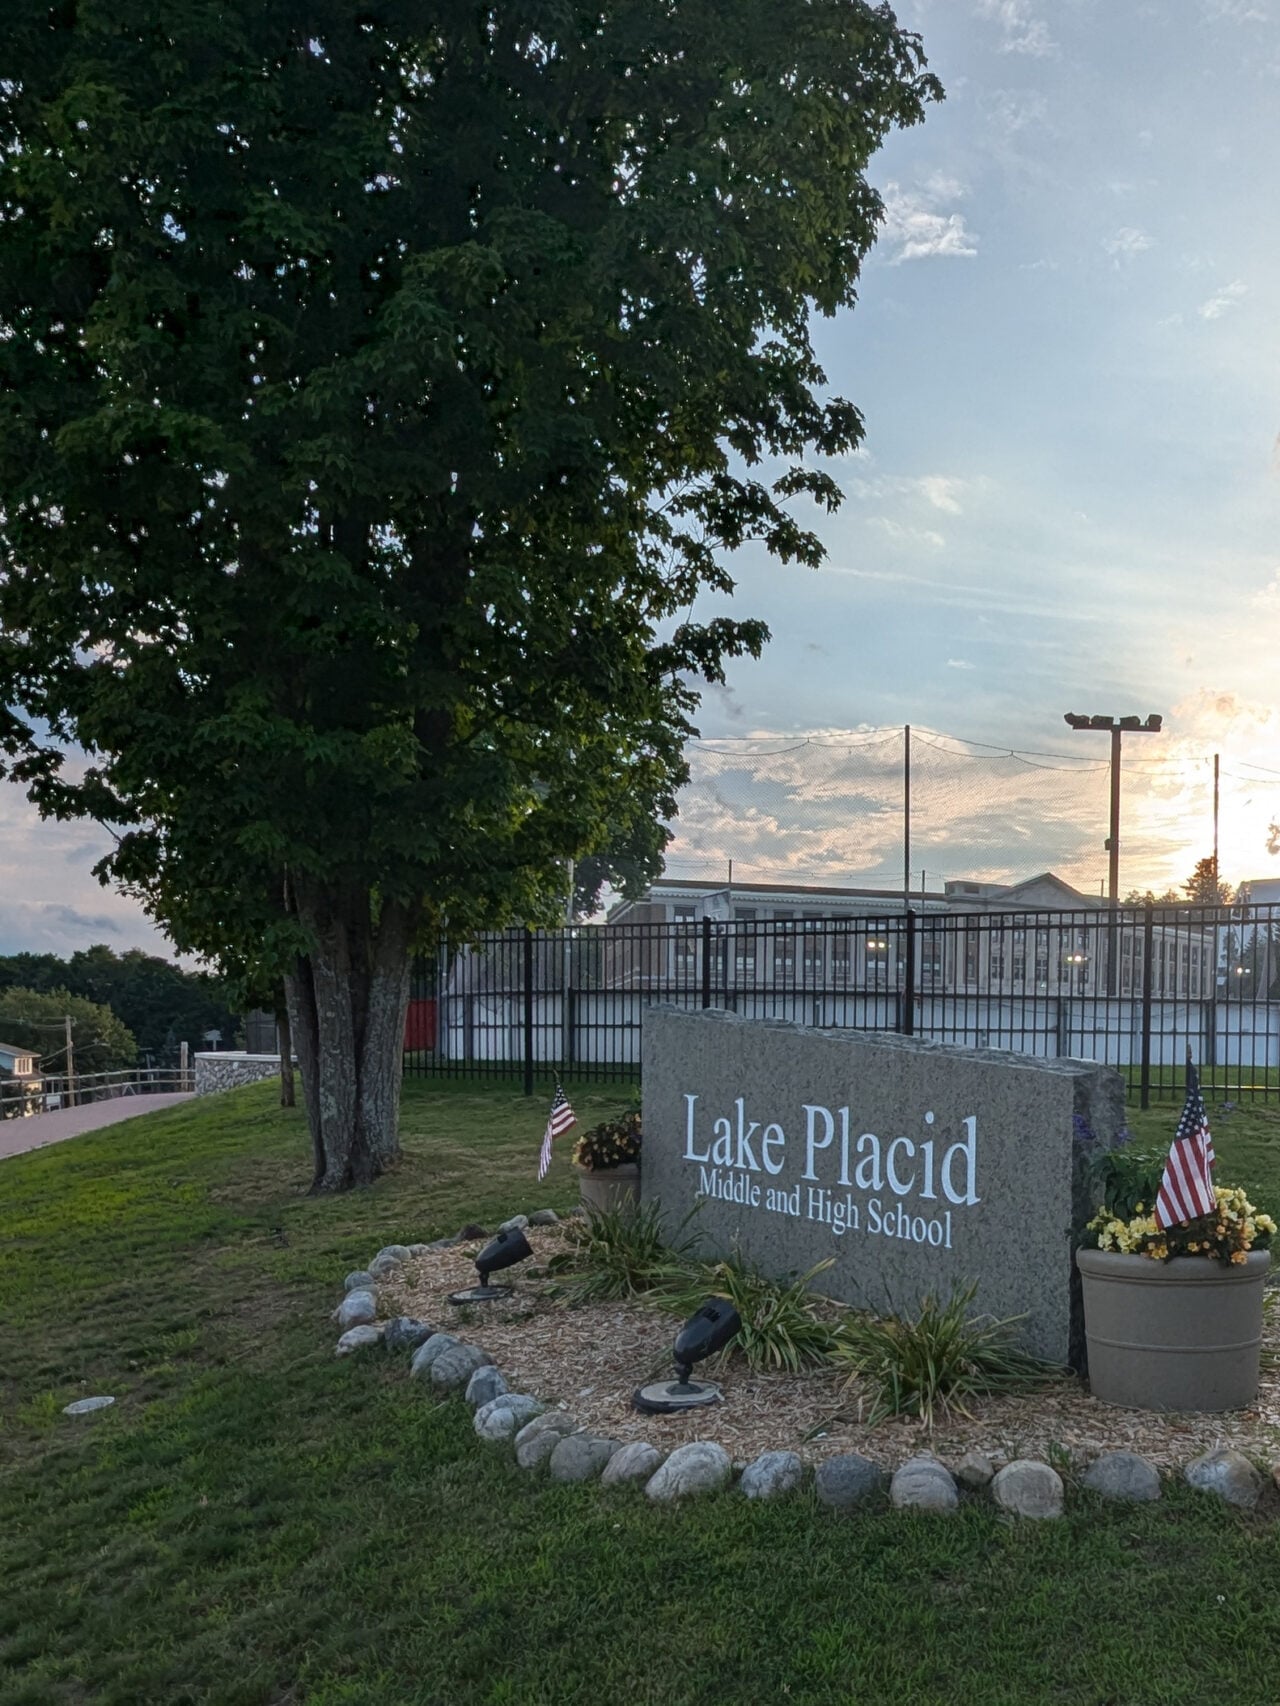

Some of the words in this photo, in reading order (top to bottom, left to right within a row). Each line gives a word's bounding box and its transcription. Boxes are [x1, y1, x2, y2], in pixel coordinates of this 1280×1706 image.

[683, 1094, 785, 1175] Lake
[801, 1104, 981, 1205] Placid
[699, 1166, 760, 1207] Middle
[766, 1185, 801, 1217] and
[807, 1187, 859, 1235] High
[867, 1198, 952, 1249] School
